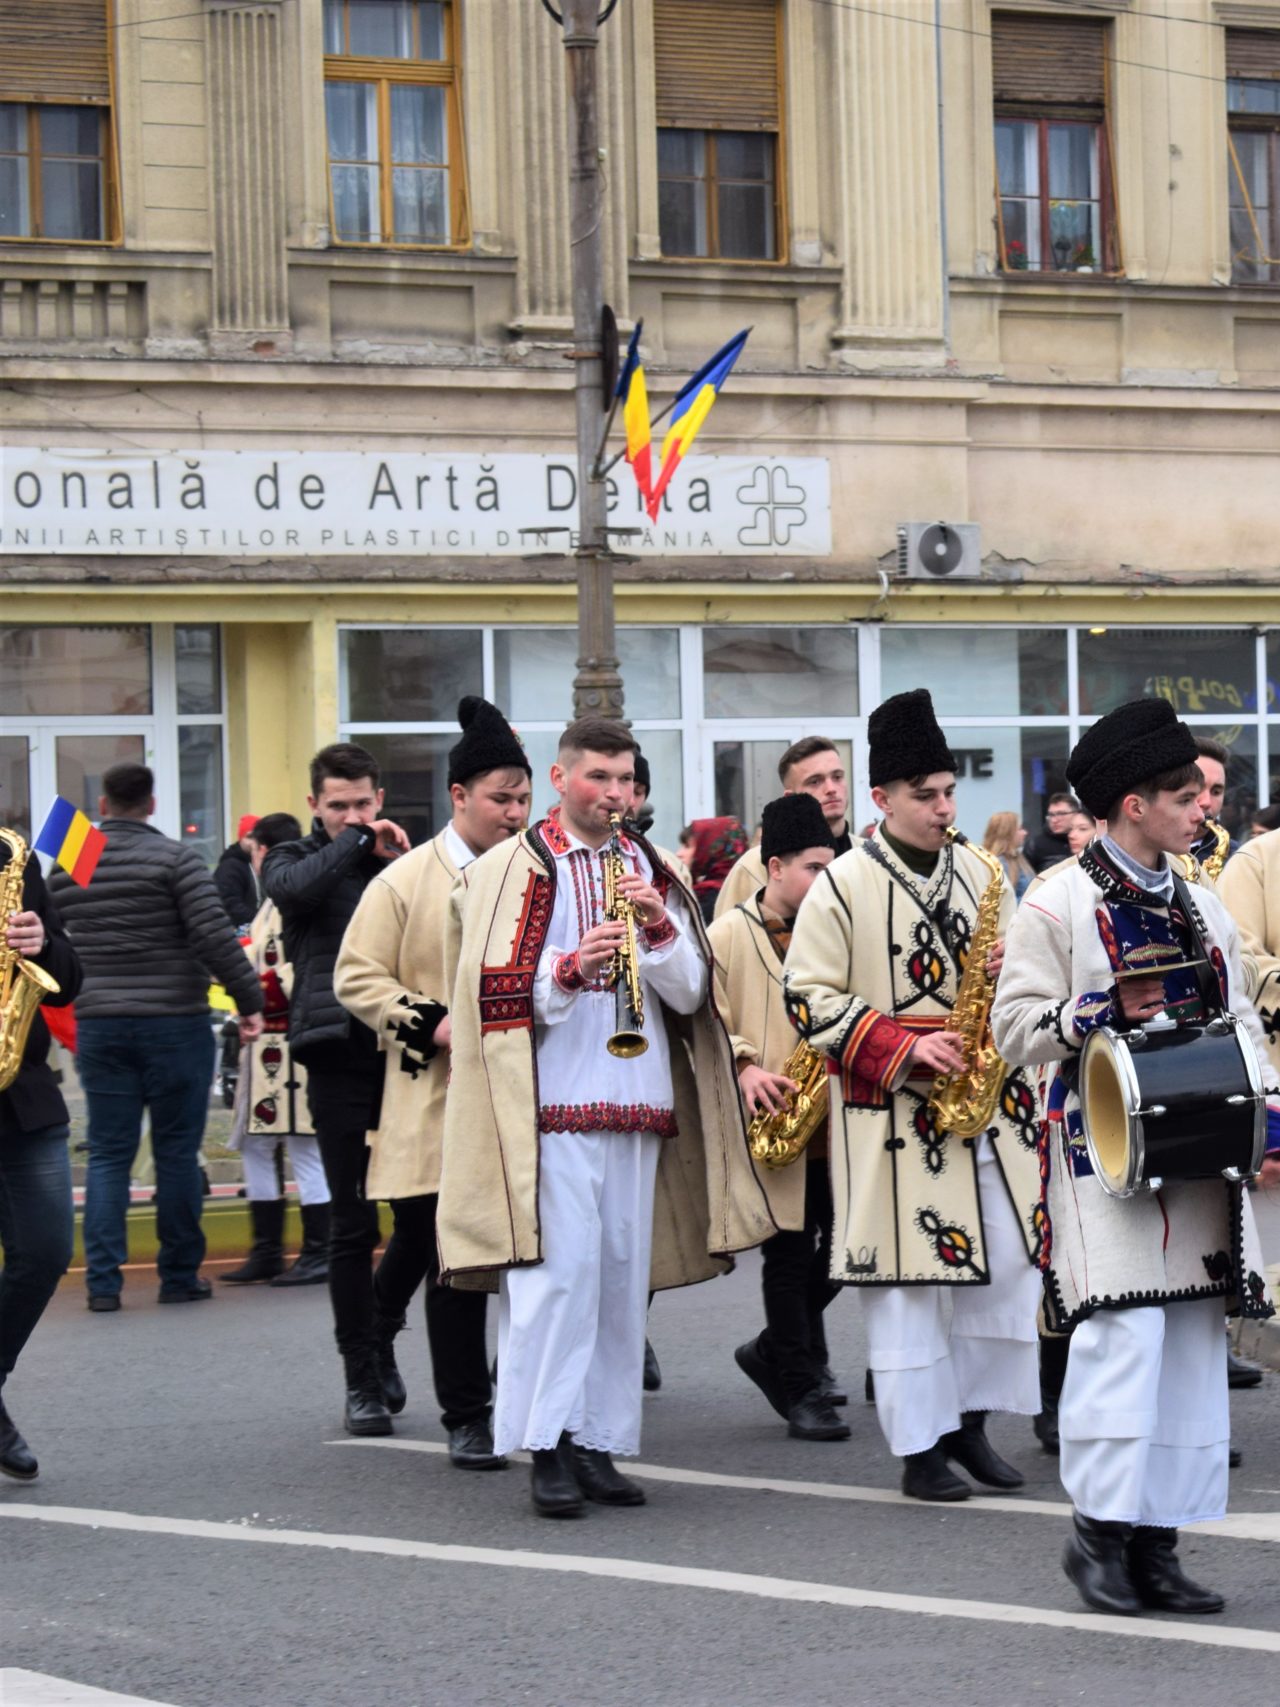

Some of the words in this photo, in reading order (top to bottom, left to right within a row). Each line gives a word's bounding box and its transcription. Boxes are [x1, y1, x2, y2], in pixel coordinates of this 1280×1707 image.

[13, 460, 207, 511] onală
[254, 461, 326, 511] de
[368, 462, 500, 512] Artă
[0, 528, 64, 546] NII
[321, 528, 476, 547] PLASTICI
[496, 530, 549, 546] DIN
